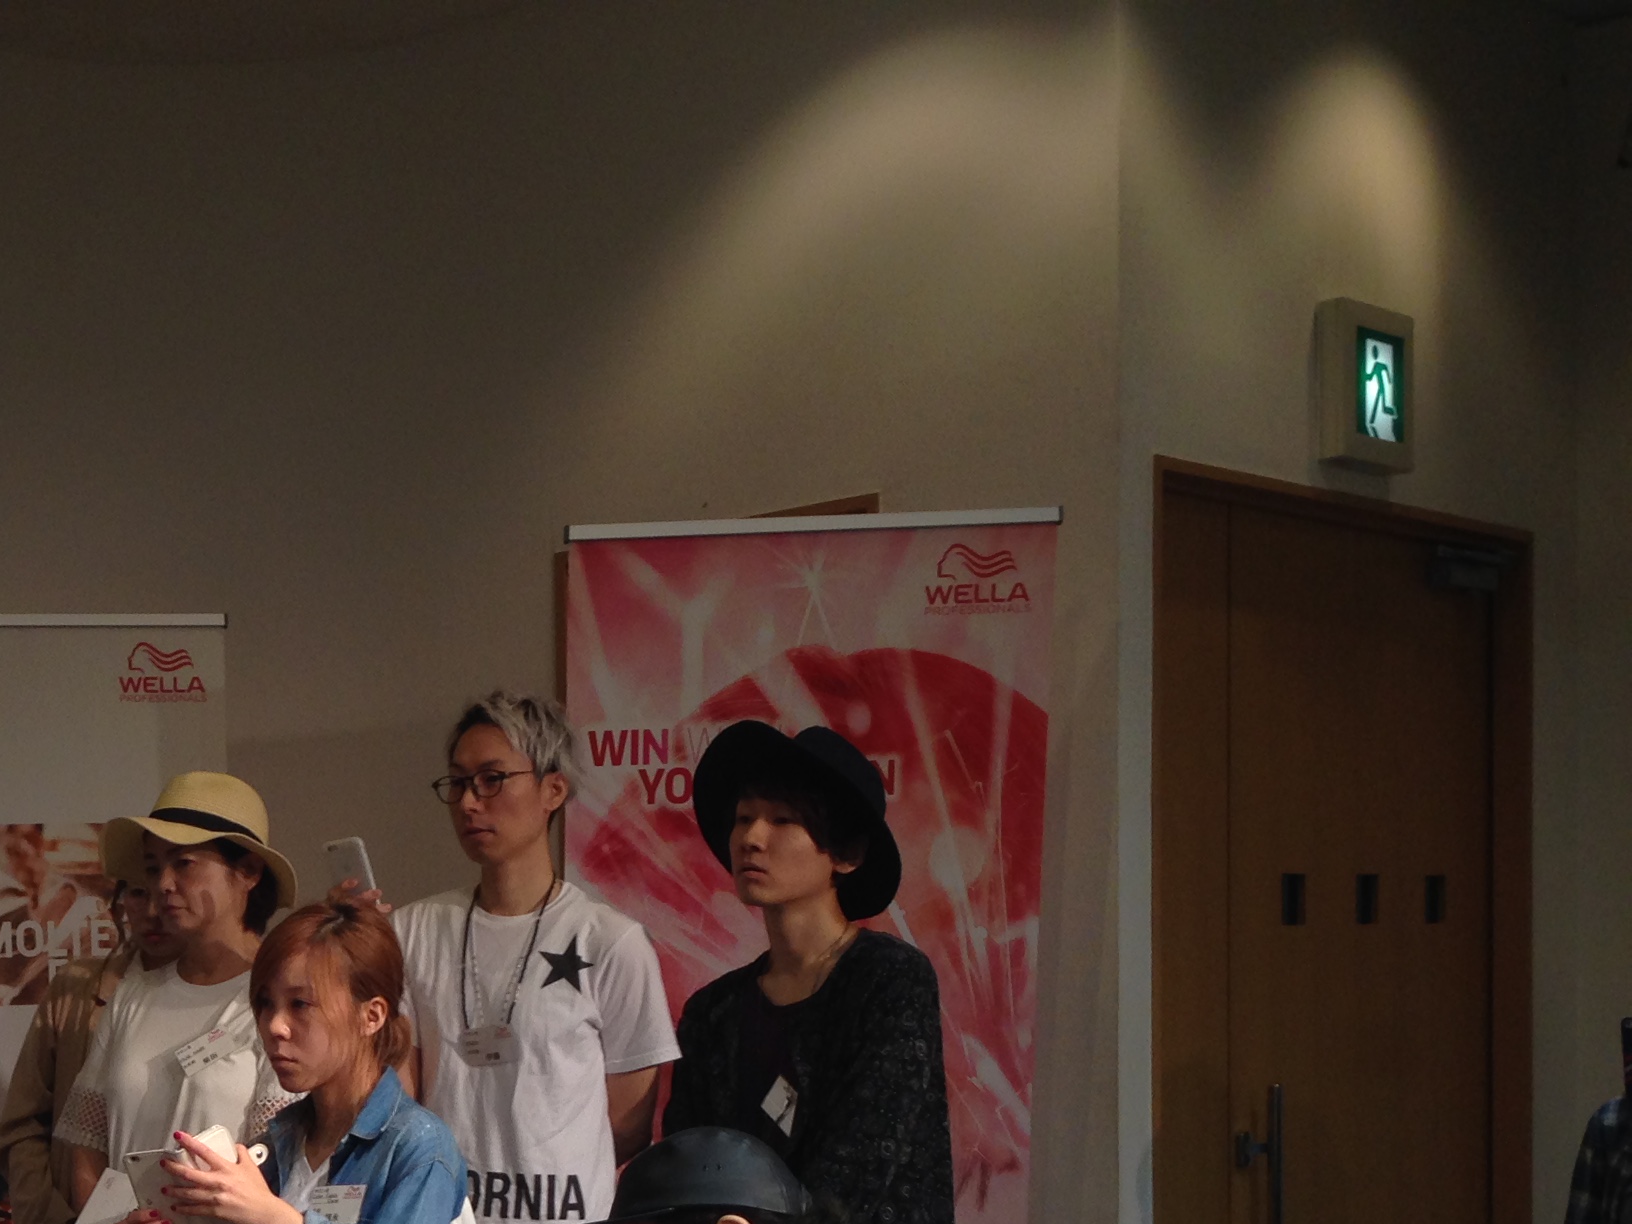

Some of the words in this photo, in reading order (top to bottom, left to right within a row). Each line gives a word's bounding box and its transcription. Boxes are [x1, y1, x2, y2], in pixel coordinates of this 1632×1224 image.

[925, 582, 1031, 605] WELLA
[118, 676, 206, 694] WELLA
[588, 728, 669, 767] WIN
